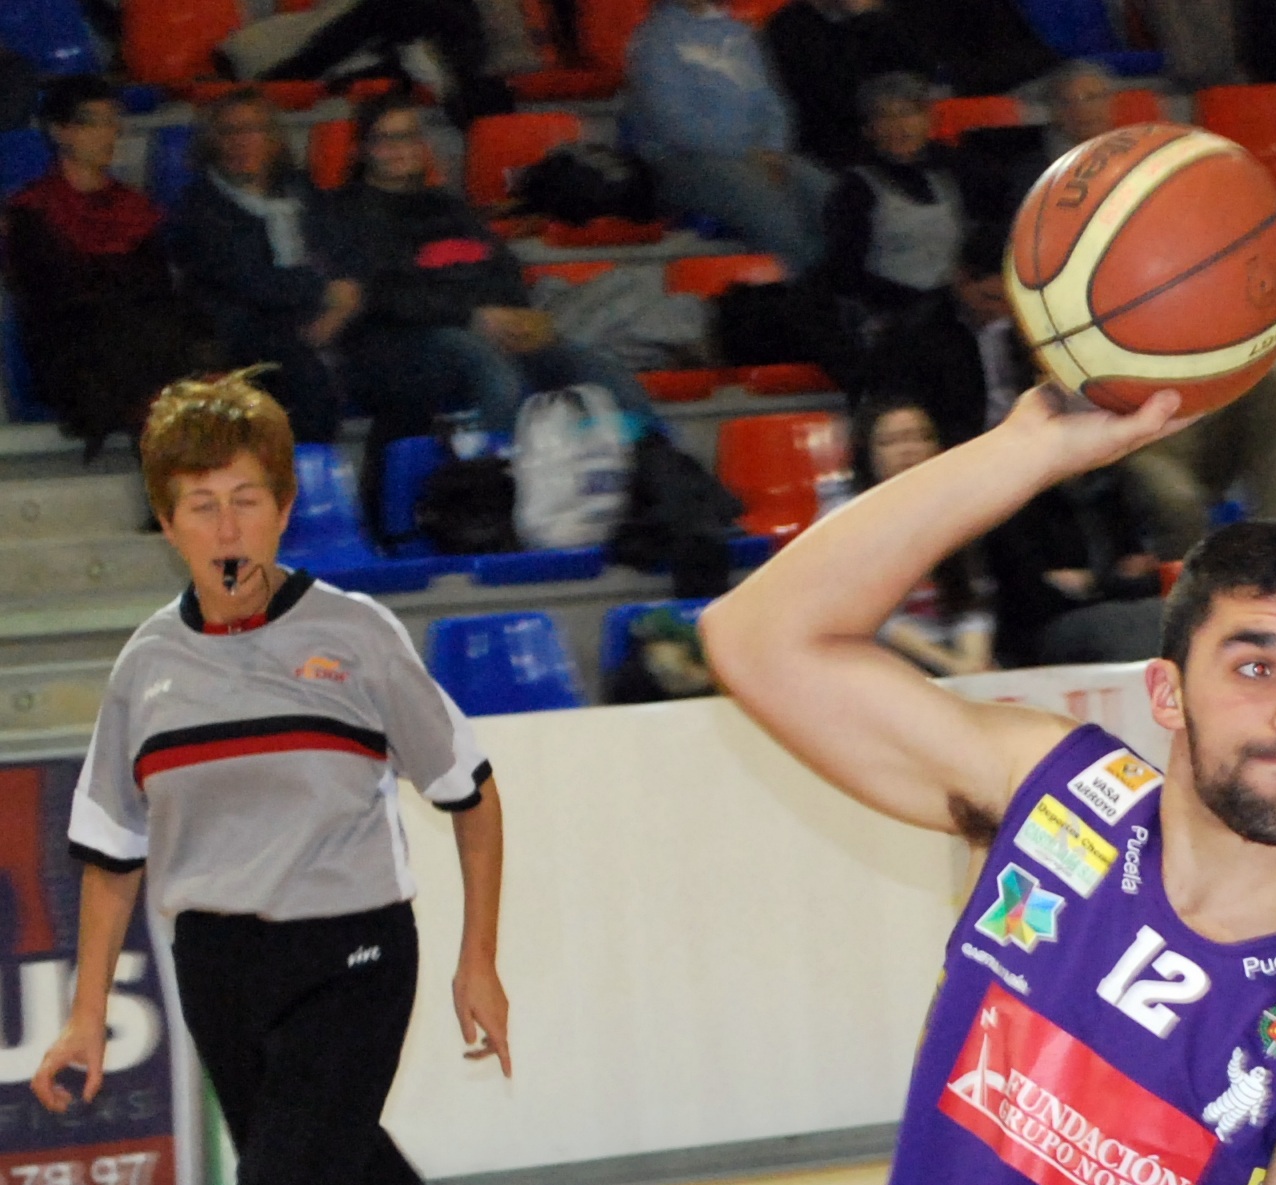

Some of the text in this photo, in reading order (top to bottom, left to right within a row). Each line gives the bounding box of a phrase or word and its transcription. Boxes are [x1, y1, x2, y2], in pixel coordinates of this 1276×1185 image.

[1121, 825, 1149, 895] Pucela
[1096, 924, 1211, 1039] 12
[980, 1006, 997, 1028] N
[998, 1098, 1077, 1166] GRUPO
